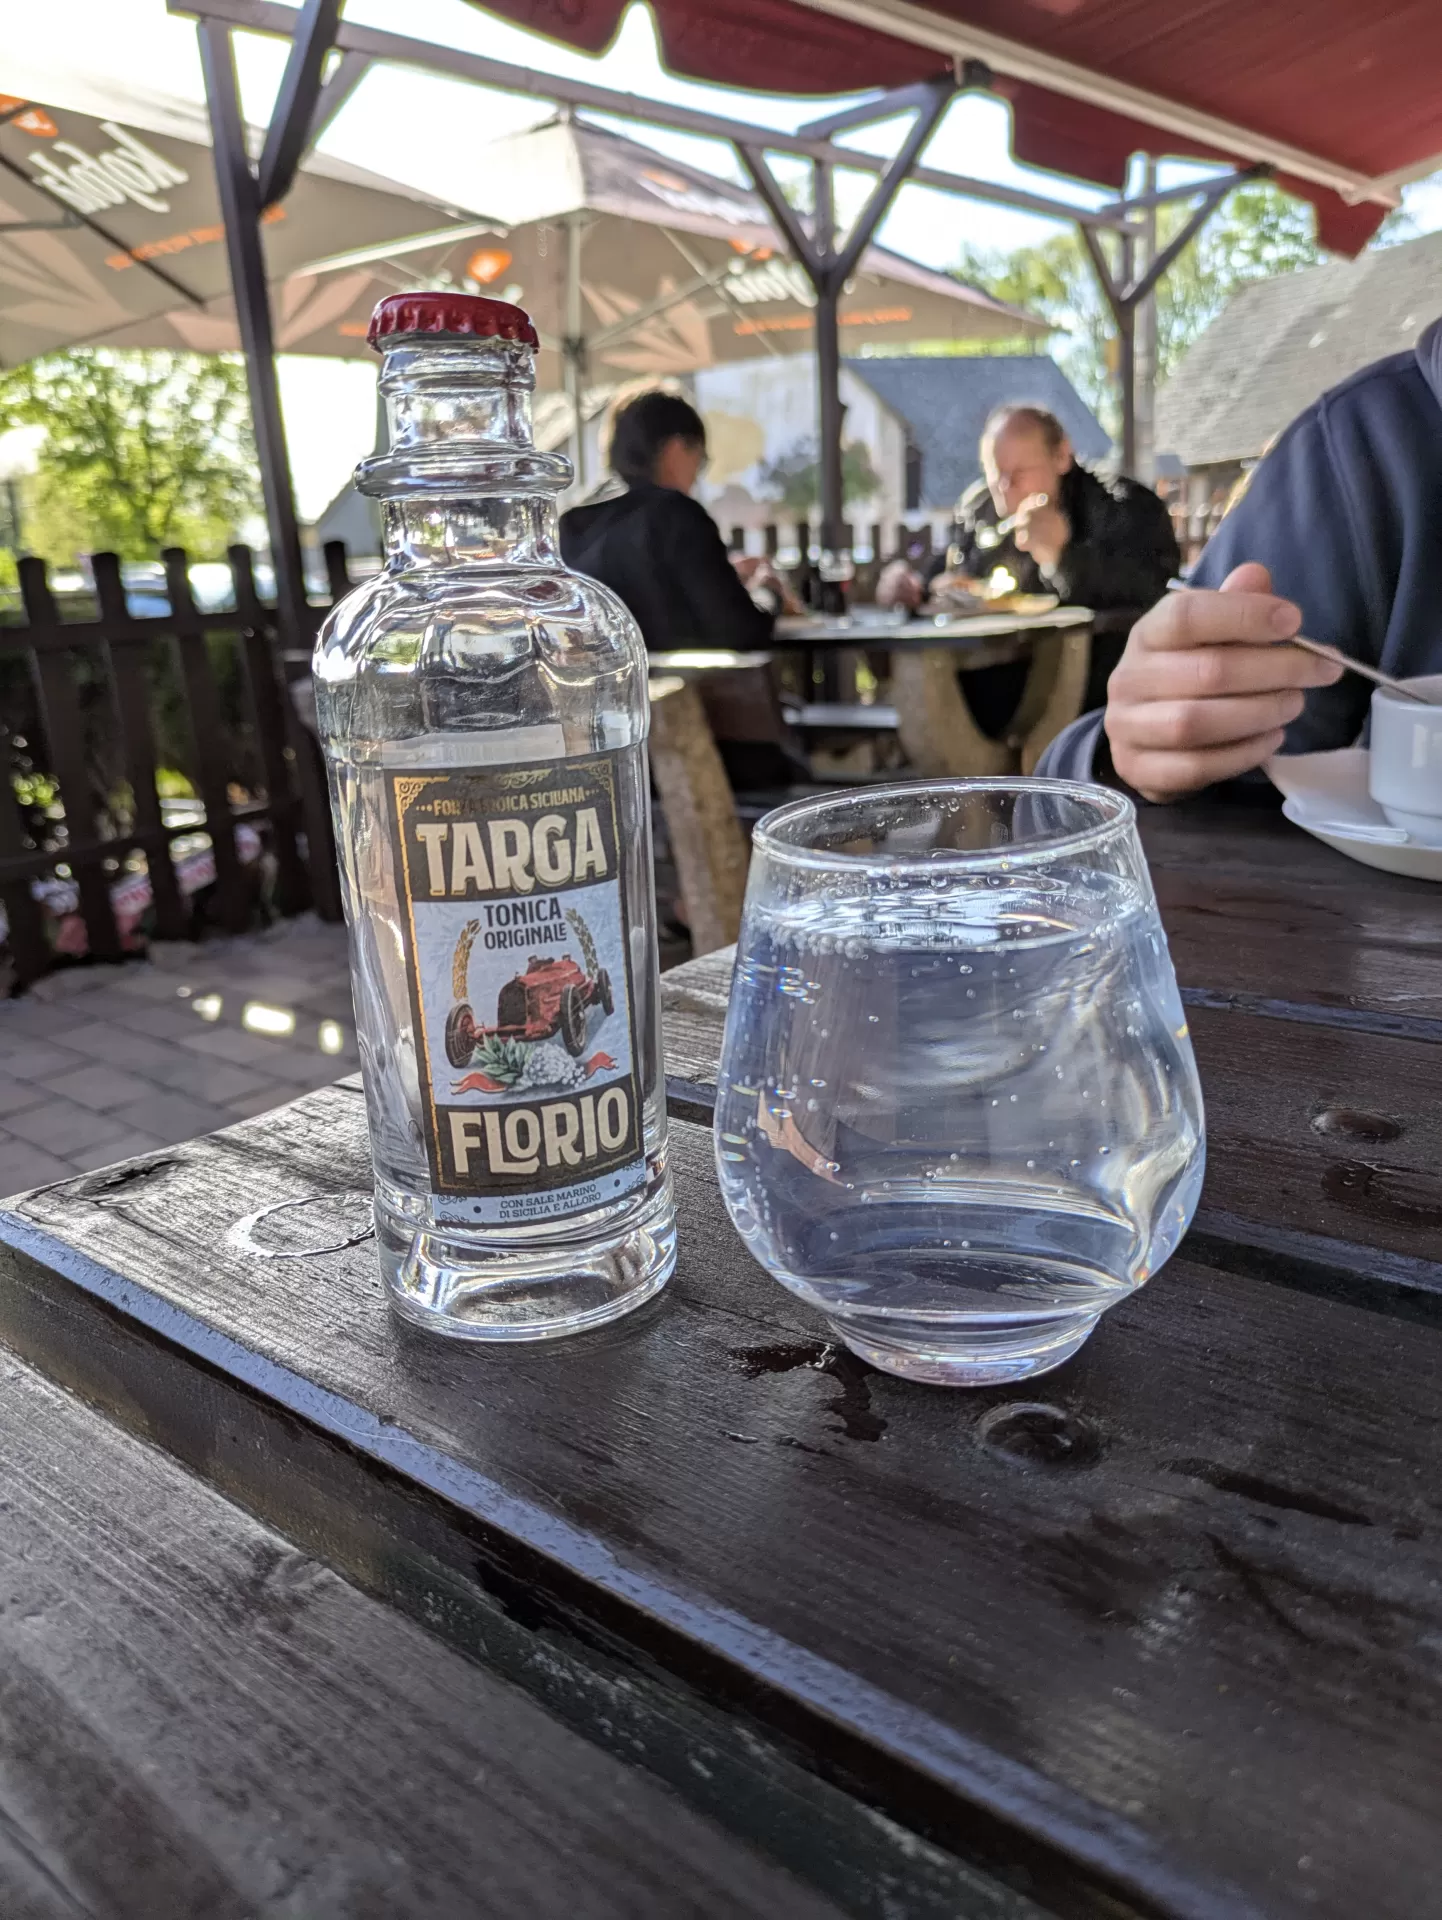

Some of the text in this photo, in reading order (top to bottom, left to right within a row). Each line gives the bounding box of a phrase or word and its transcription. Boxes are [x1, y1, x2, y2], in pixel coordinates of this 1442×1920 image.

[530, 786, 586, 809] SICILIANA
[415, 807, 608, 896] TARGA
[484, 897, 562, 928] TONICA
[484, 922, 567, 950] ORIGINALE
[448, 1087, 629, 1178] FLORIO
[499, 1192, 602, 1219] DI SICILIA E ALLORO
[500, 1183, 597, 1209] CON SALE MARINO
